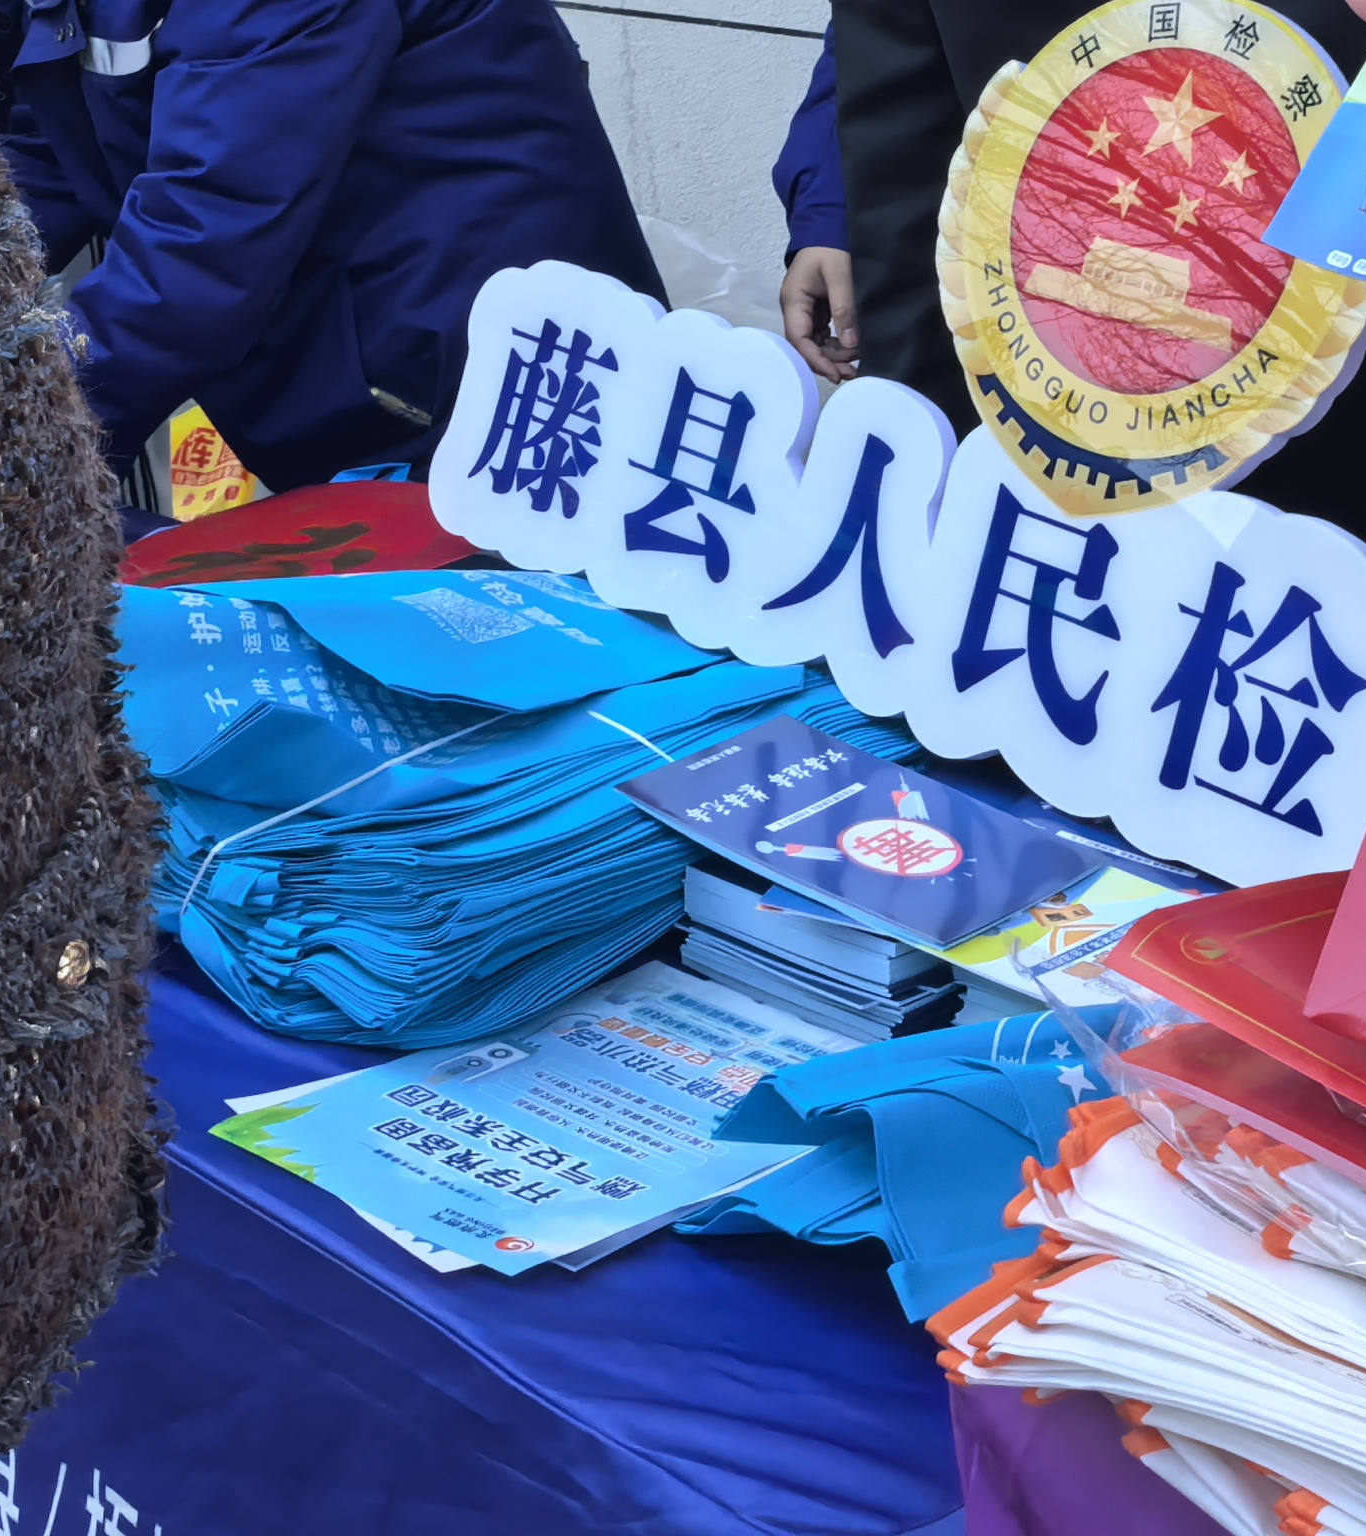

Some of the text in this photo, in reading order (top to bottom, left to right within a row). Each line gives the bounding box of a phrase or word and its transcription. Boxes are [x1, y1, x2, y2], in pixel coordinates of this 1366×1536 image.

[1070, 1, 1324, 123] 中国检察
[983, 257, 1280, 433] ZHONGGUO JIANCHA
[369, 1115, 565, 1206] 开学预备周
[382, 1082, 648, 1201] 燃气安全系校园
[426, 1211, 497, 1242] 北京燃气
